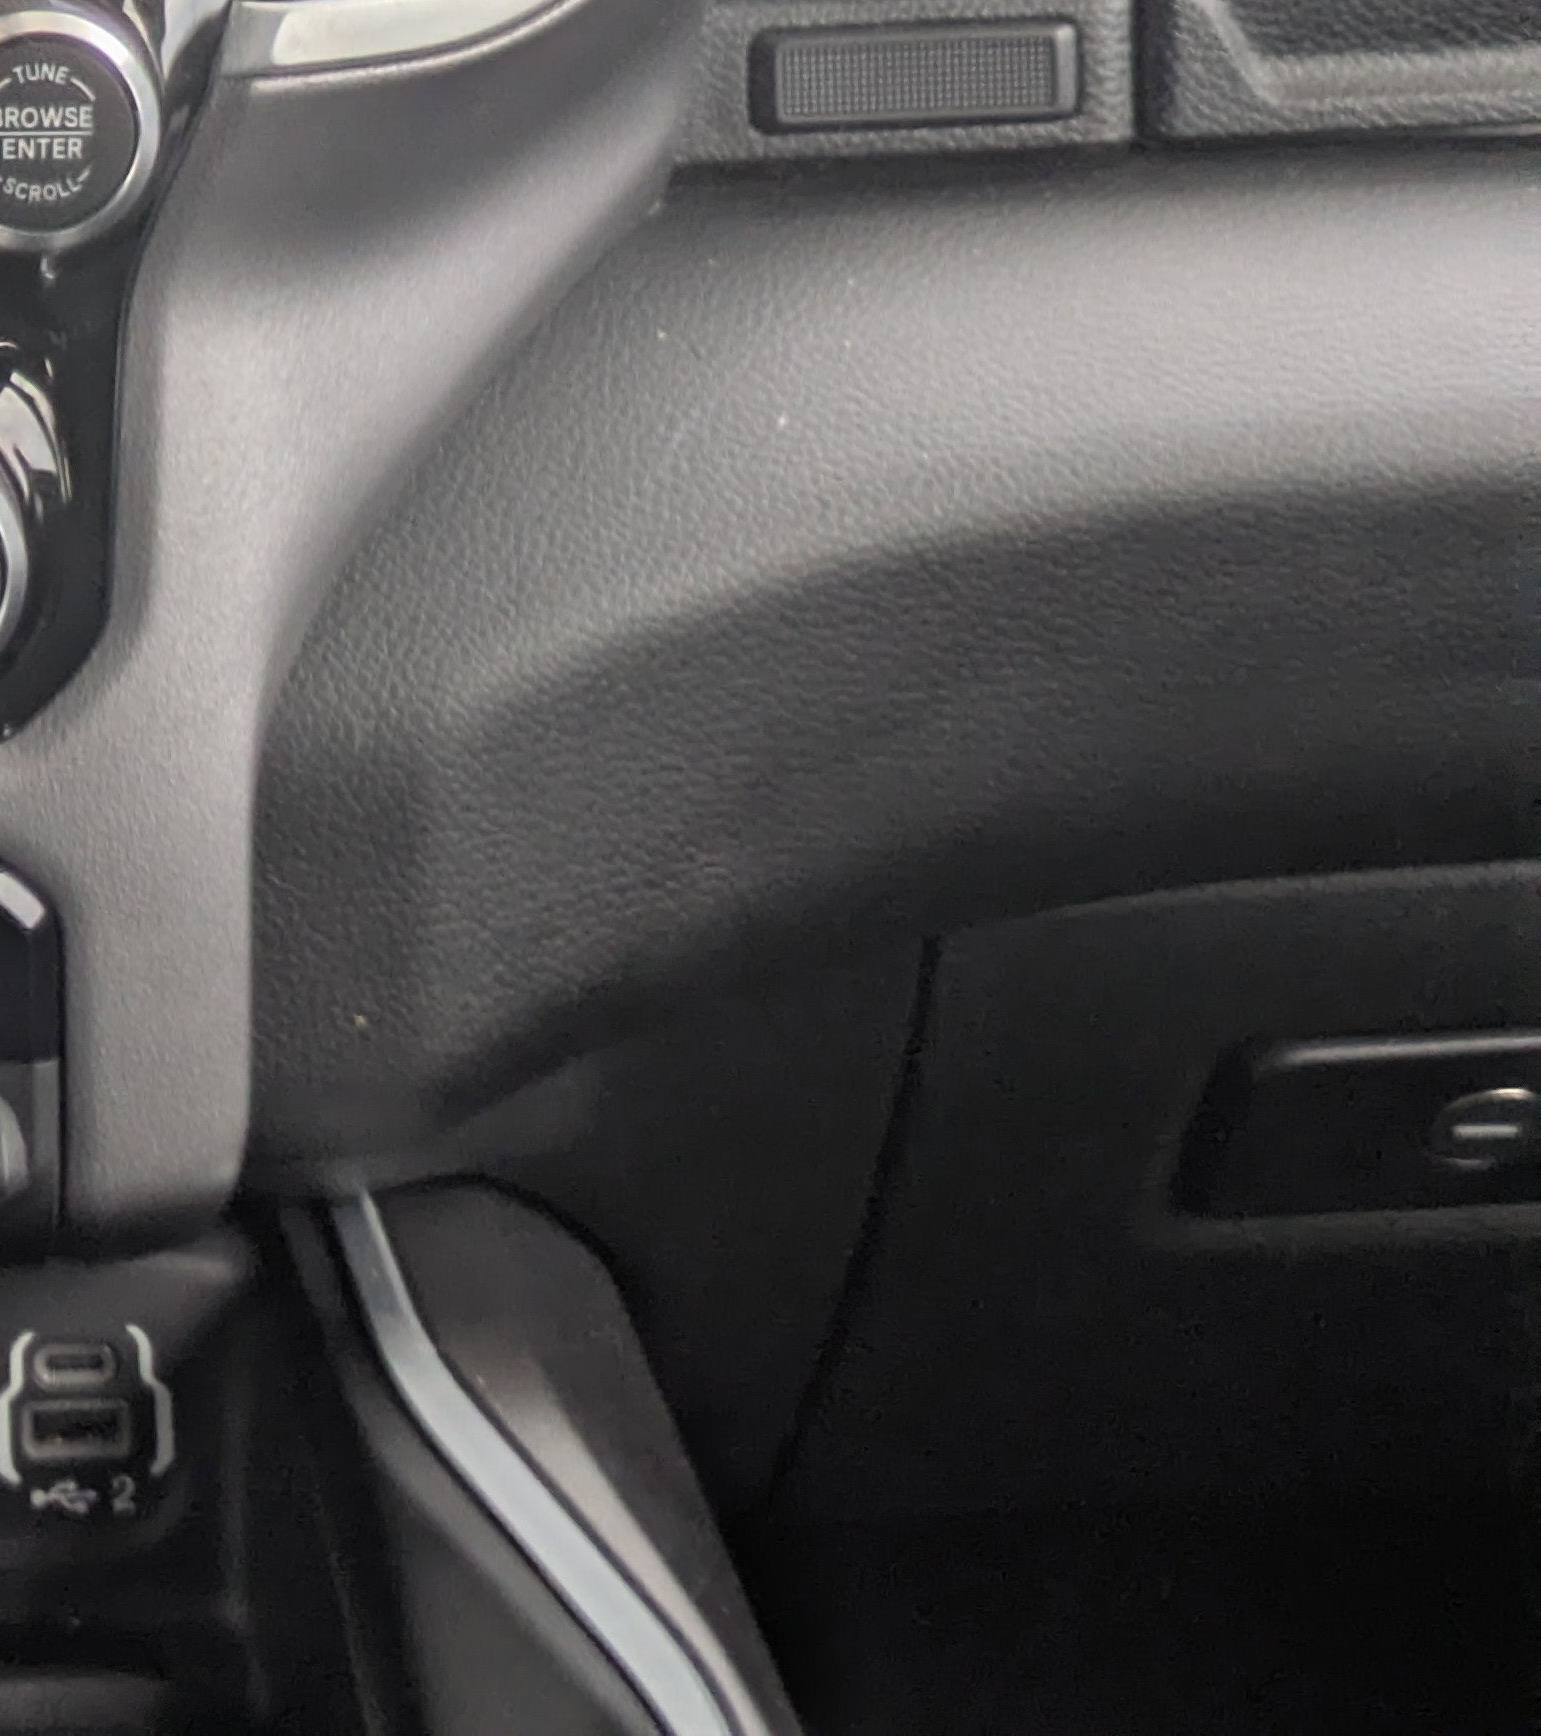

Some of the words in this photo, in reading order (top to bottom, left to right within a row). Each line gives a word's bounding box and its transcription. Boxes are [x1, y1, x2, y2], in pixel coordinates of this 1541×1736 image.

[12, 63, 69, 85] TUNE
[1, 137, 83, 160] ENTER
[2, 176, 82, 204] SCROLL
